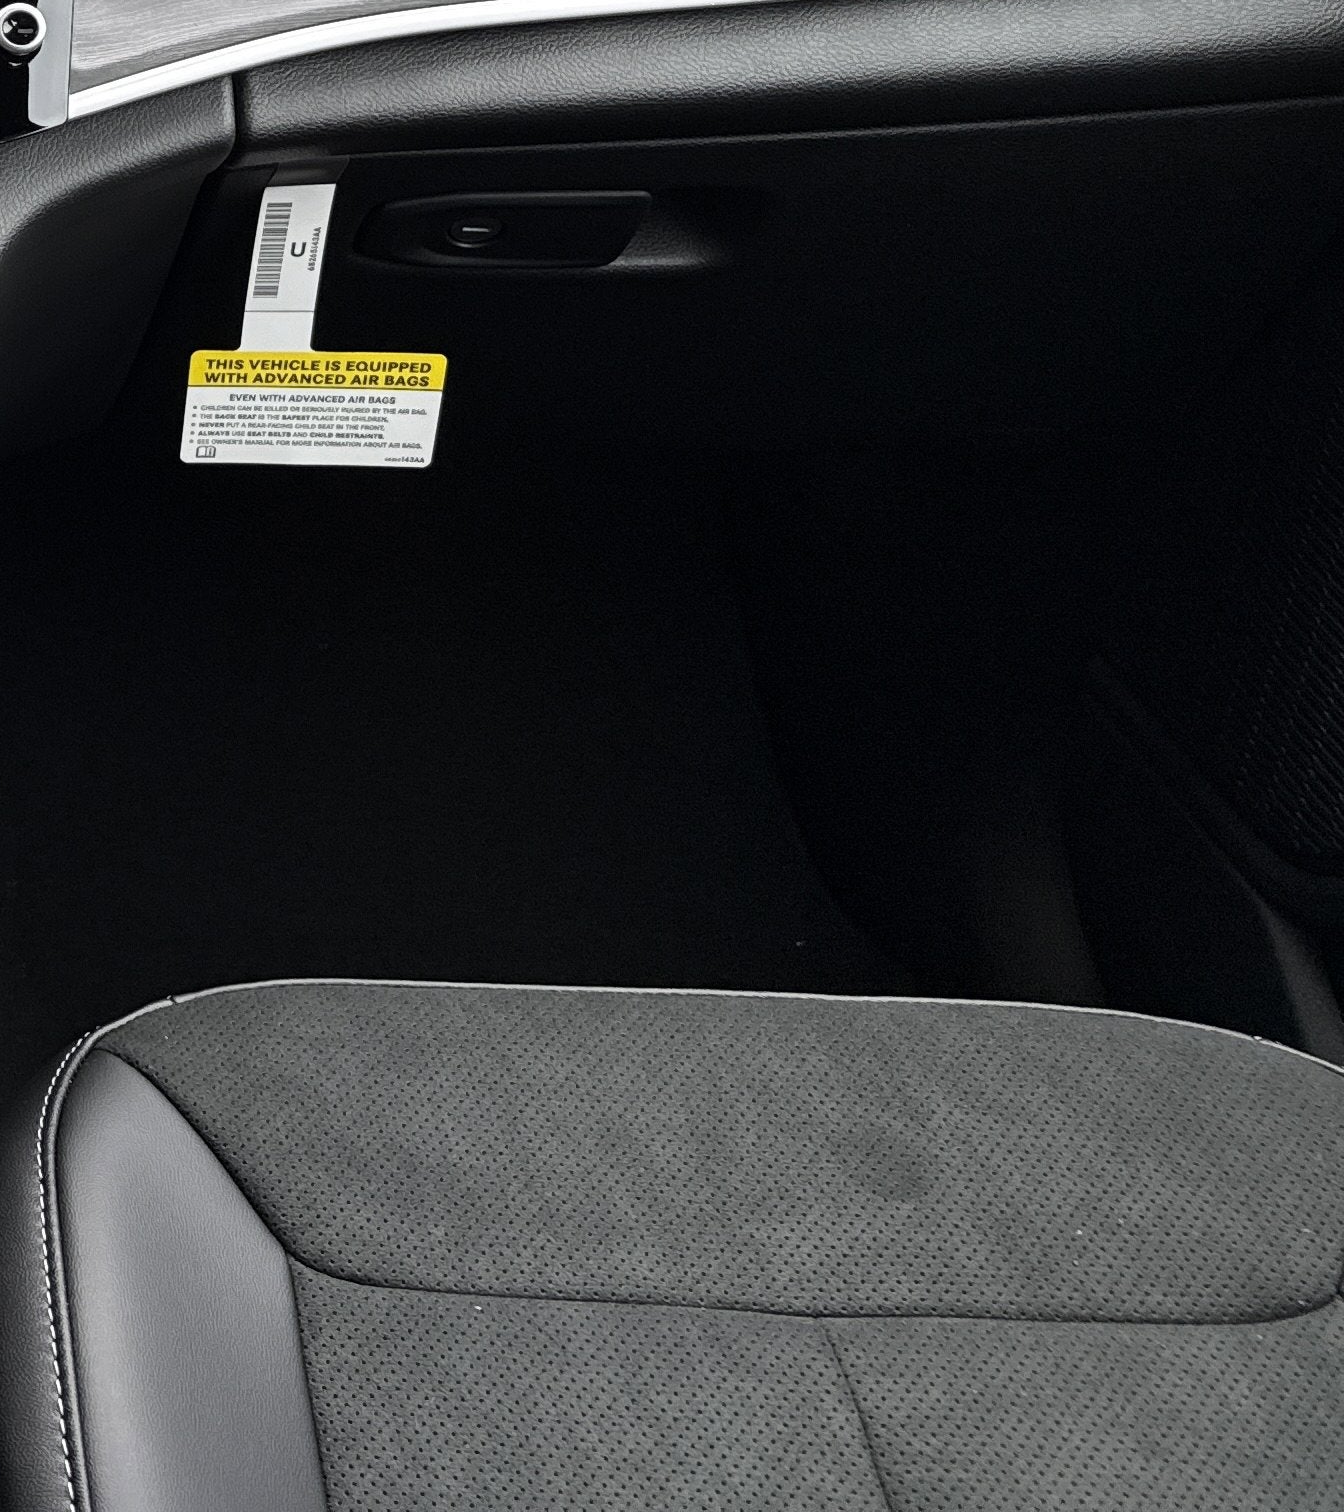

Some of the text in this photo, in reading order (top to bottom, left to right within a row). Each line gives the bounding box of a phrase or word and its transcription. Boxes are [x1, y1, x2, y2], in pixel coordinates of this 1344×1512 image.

[291, 242, 306, 257] U
[206, 359, 432, 373] THIS VEHICLE IS EQUIPPED
[204, 373, 430, 387] WITH ADVANCED AIR BAGS
[229, 393, 396, 405] EVEN WITH ADVANCED AIR BAGS
